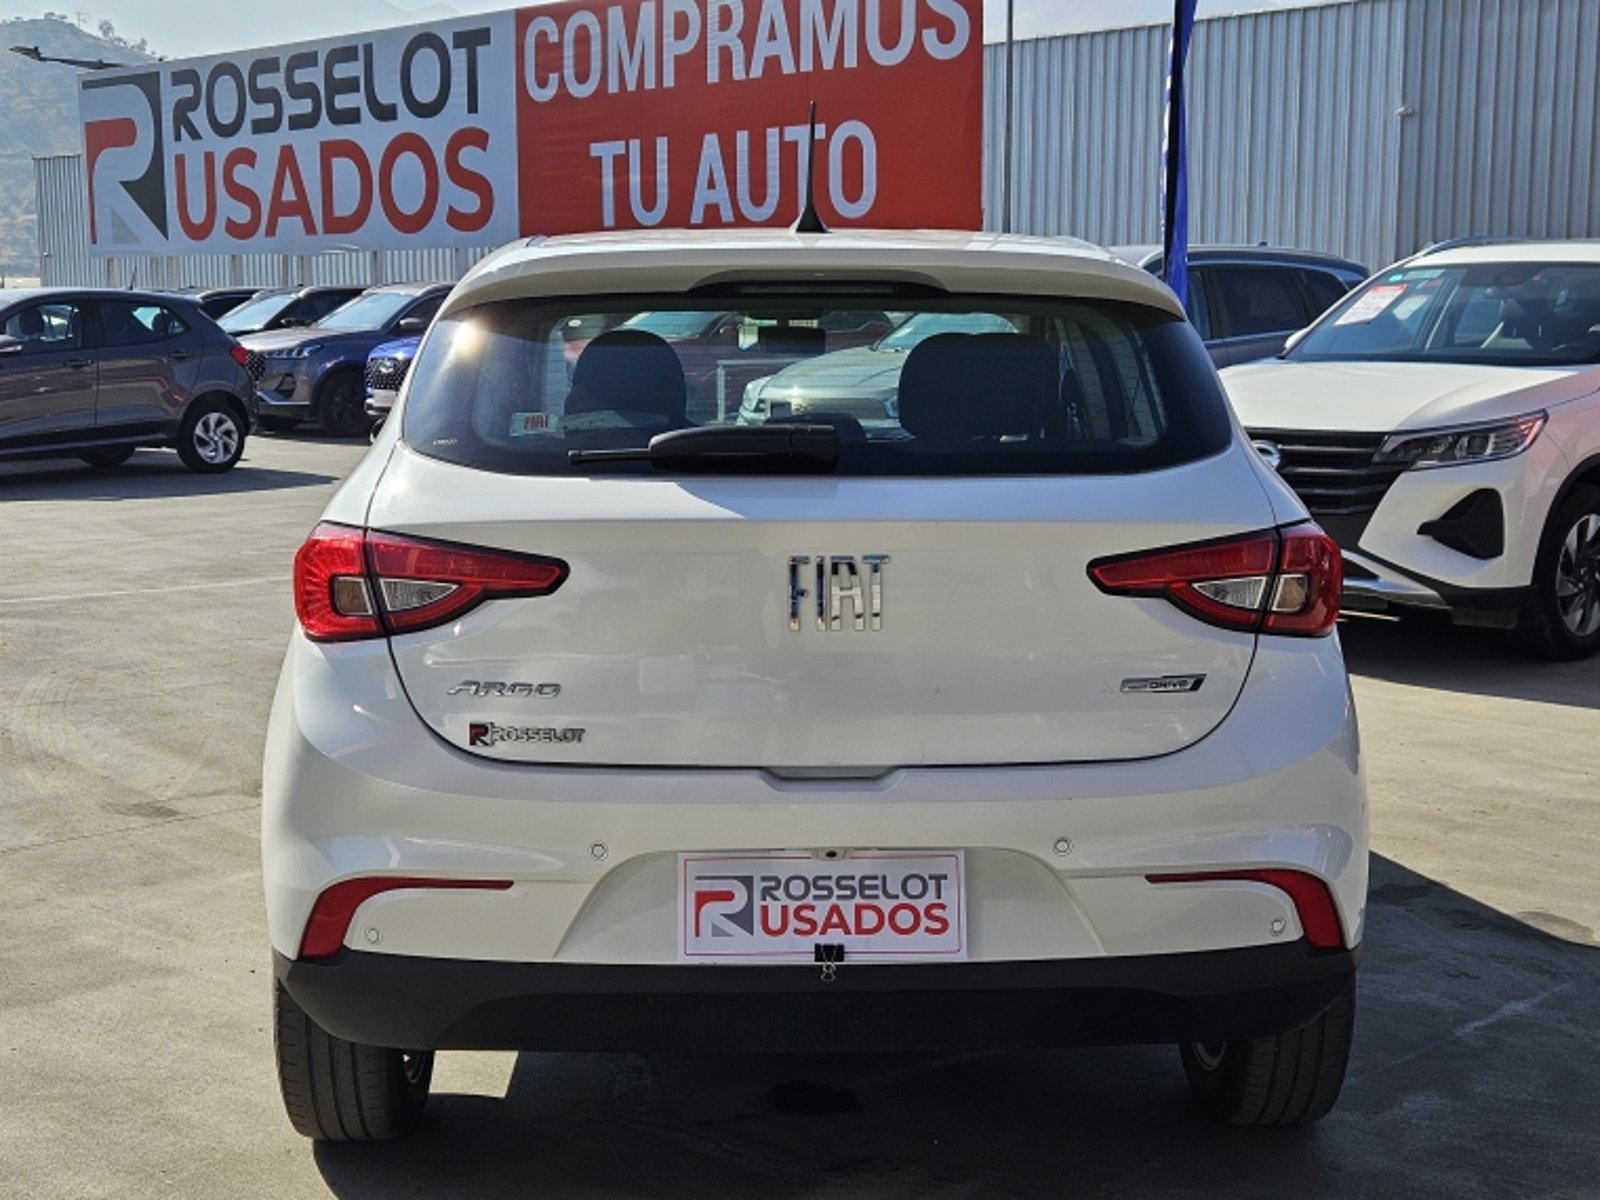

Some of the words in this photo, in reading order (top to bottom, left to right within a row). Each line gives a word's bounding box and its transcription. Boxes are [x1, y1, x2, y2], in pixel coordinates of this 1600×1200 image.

[171, 27, 491, 142] ROSSELOT
[524, 0, 971, 101] COMPRAMOS
[174, 127, 495, 241] USADOS
[589, 136, 669, 228] TU
[690, 120, 877, 225] AUTO
[788, 553, 891, 632] FIAT
[447, 680, 562, 697] ARGO
[493, 726, 586, 744] ROSSELOT
[760, 873, 948, 902] ROSSELOT
[760, 903, 950, 938] USADOS
